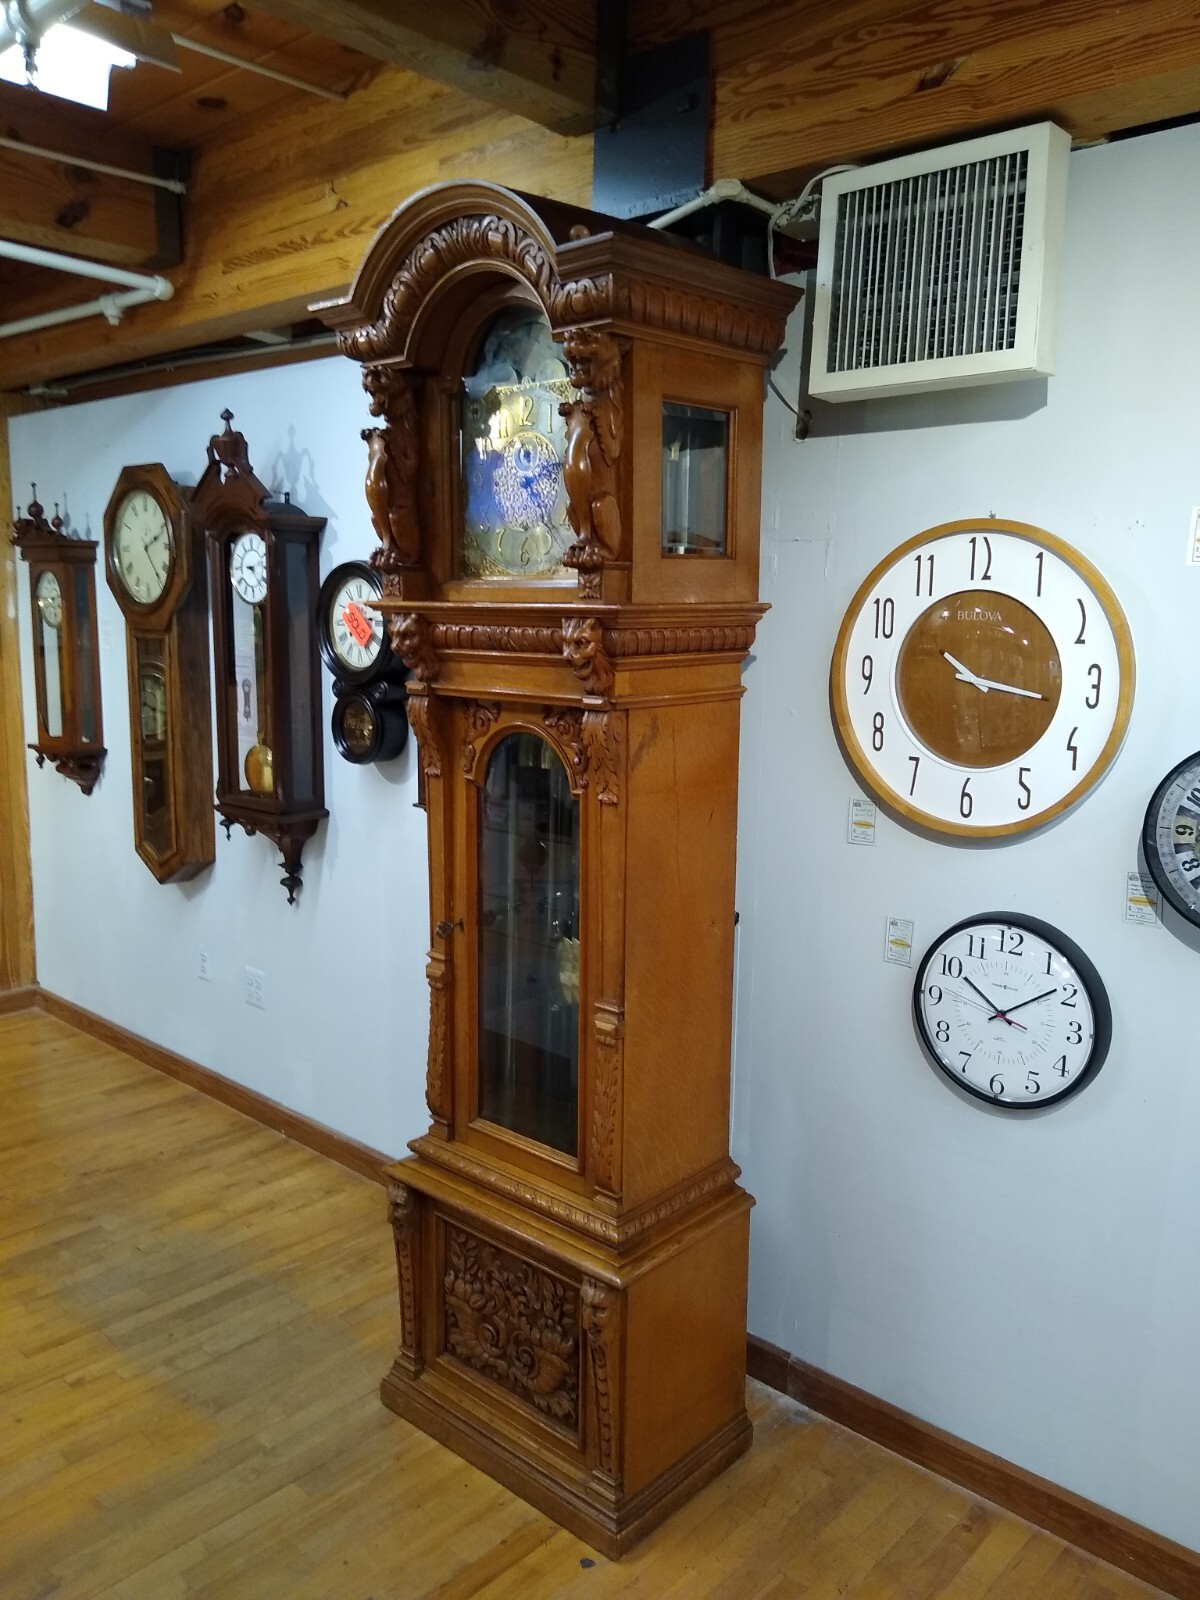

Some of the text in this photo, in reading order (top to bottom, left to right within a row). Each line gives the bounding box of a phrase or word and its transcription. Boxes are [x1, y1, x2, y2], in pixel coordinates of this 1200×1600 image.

[519, 395, 534, 427] 12
[521, 537, 530, 566] 6
[969, 536, 992, 581] 12
[914, 554, 934, 597] 11
[1035, 552, 1043, 597] 1
[347, 612, 367, 640] SOLD
[873, 597, 894, 639] 10
[957, 610, 1002, 621] BULOVA
[1074, 599, 1086, 644] 2
[862, 655, 873, 695] 9
[1086, 663, 1101, 709] 3
[872, 712, 885, 751] 8
[1066, 726, 1079, 771] 4
[908, 756, 920, 796] 7
[1018, 767, 1031, 810] 5
[960, 777, 973, 818] 6
[1175, 824, 1194, 836] 9
[1181, 858, 1200, 872] 8
[965, 933, 987, 961] 11
[996, 929, 1024, 957] 12
[938, 953, 963, 979] 10
[1042, 951, 1055, 976] 1
[928, 984, 943, 1006] 9
[1060, 983, 1078, 1008] 2
[935, 1020, 950, 1043] 8
[1066, 1020, 1083, 1045] 3
[958, 1050, 972, 1073] 7
[1052, 1054, 1070, 1079] 4
[989, 1073, 1005, 1095] 6
[1024, 1070, 1041, 1094] 5
